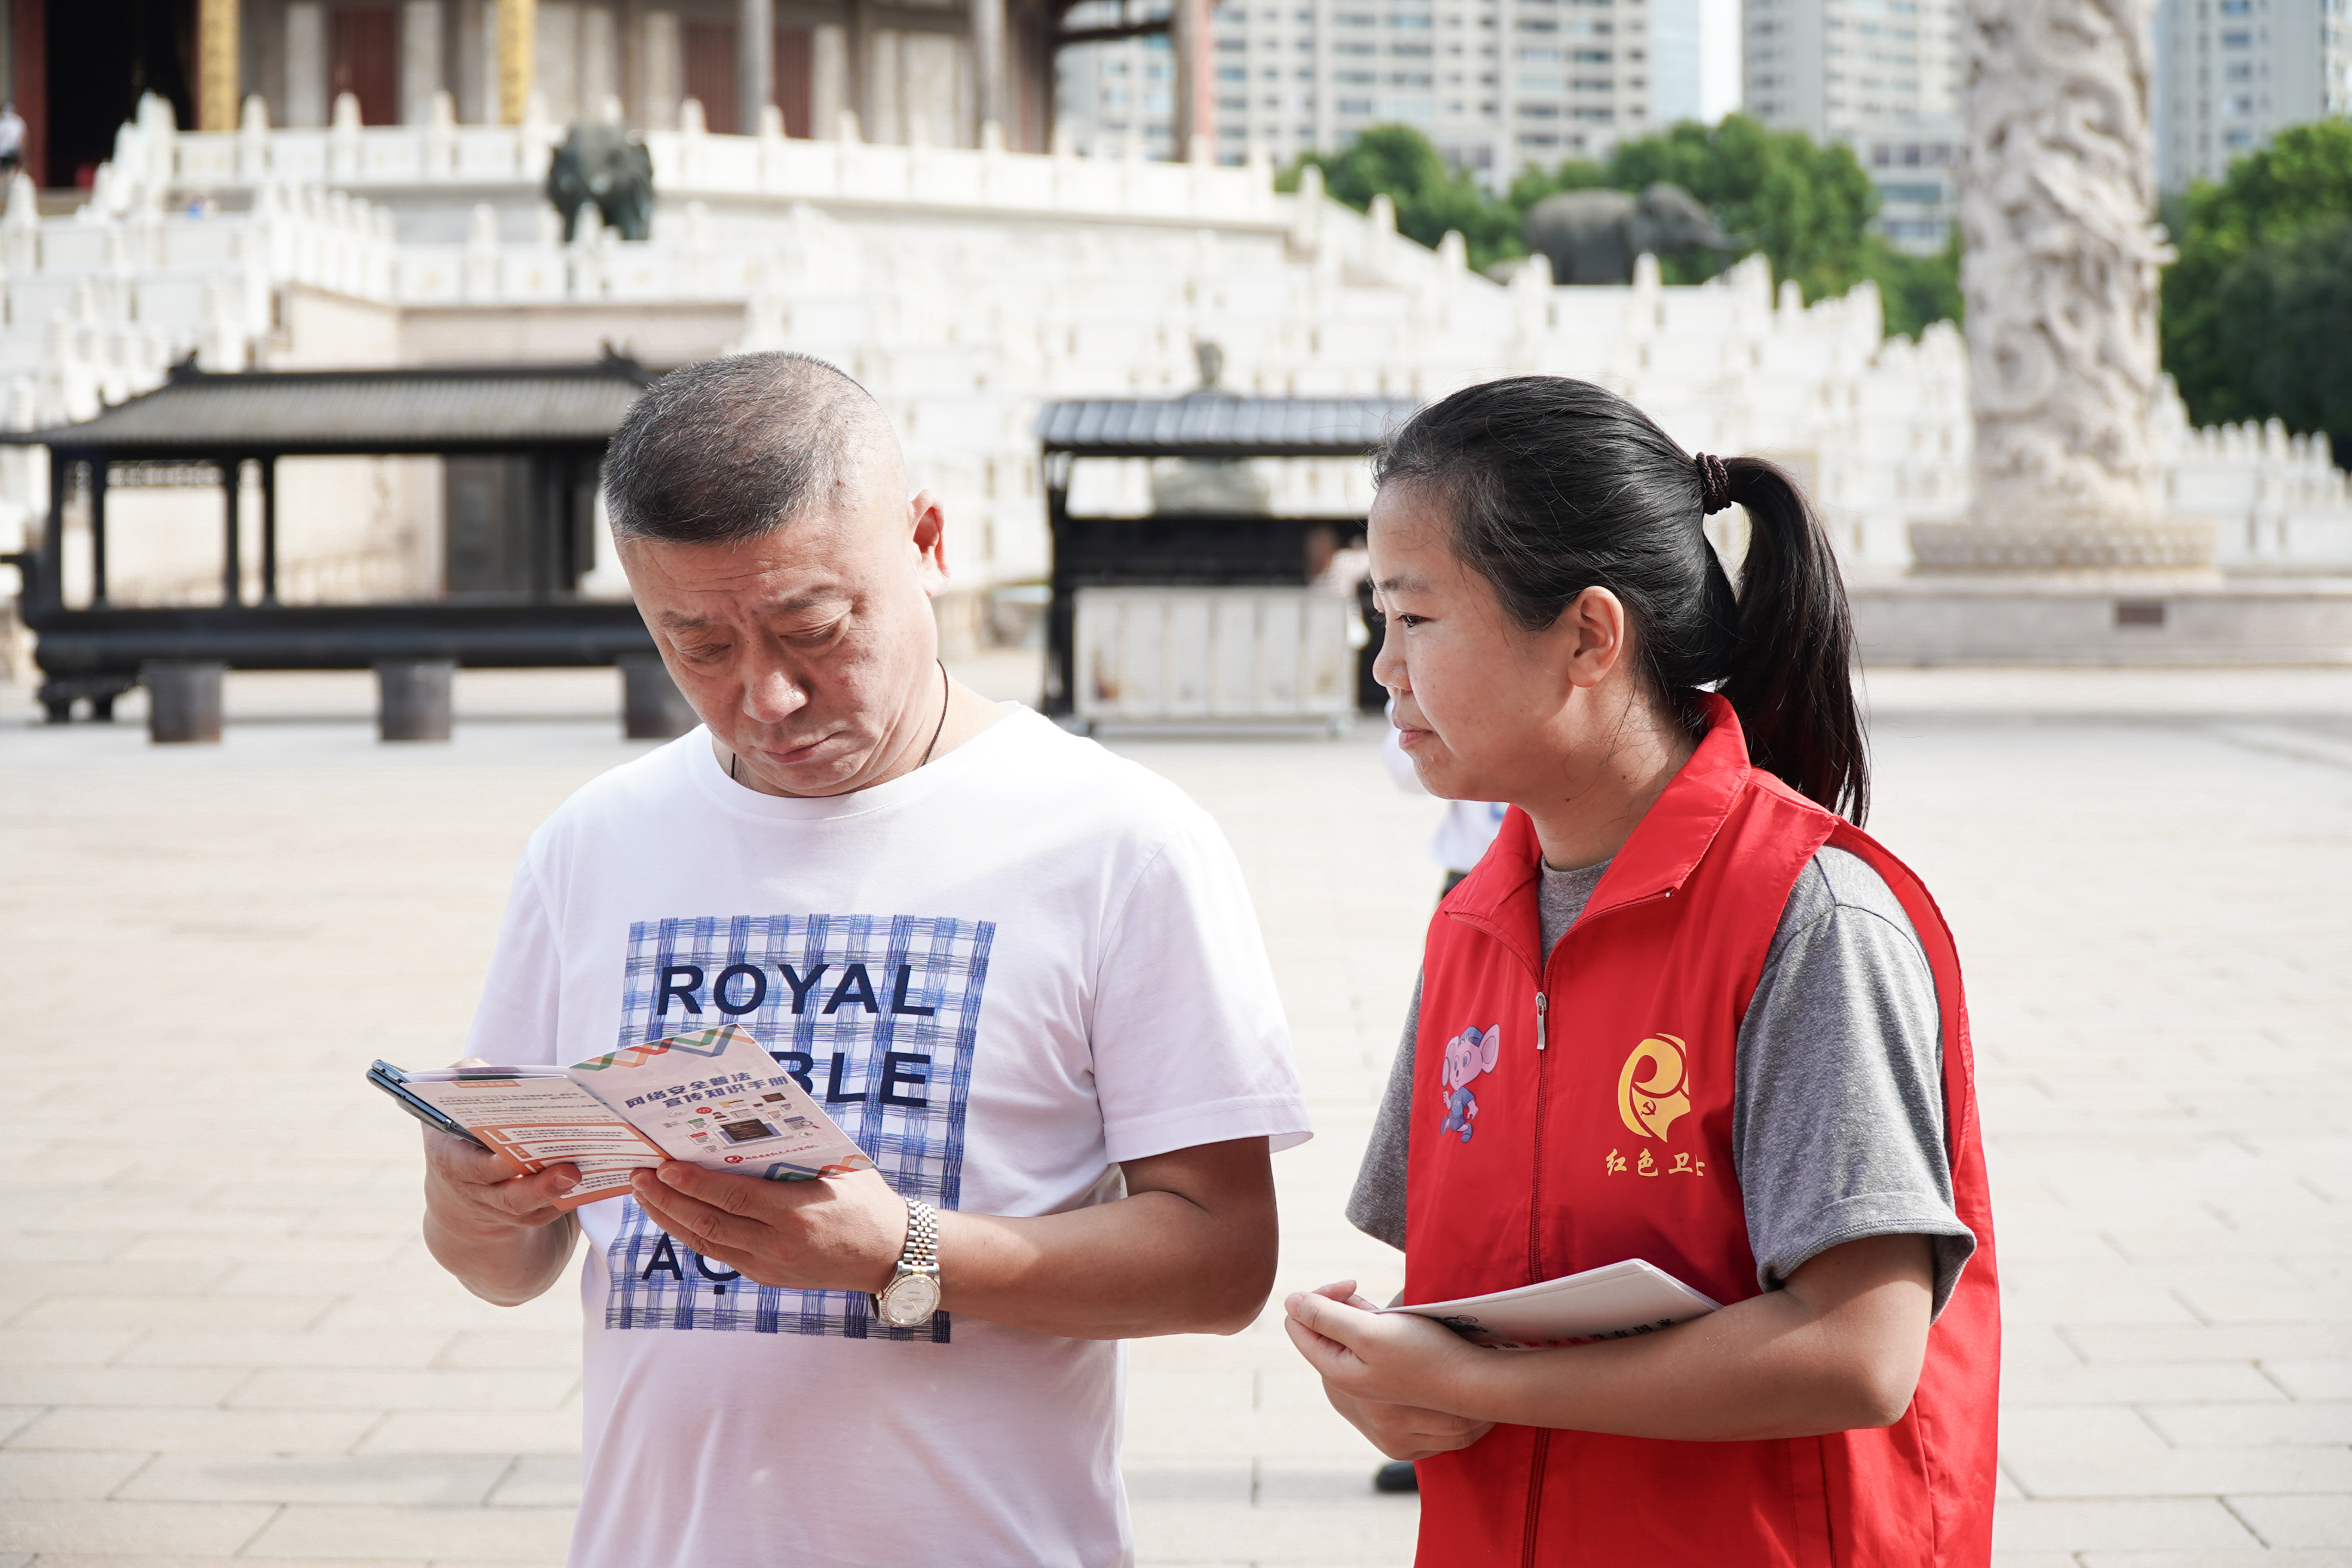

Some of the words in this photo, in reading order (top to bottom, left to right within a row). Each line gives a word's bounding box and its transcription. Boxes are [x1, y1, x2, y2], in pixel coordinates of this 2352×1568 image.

[657, 963, 935, 1016] ROYAL
[625, 1072, 752, 1108] 网络安全普法
[664, 1076, 789, 1108] 宣传知识手册
[768, 1051, 931, 1108] BLE
